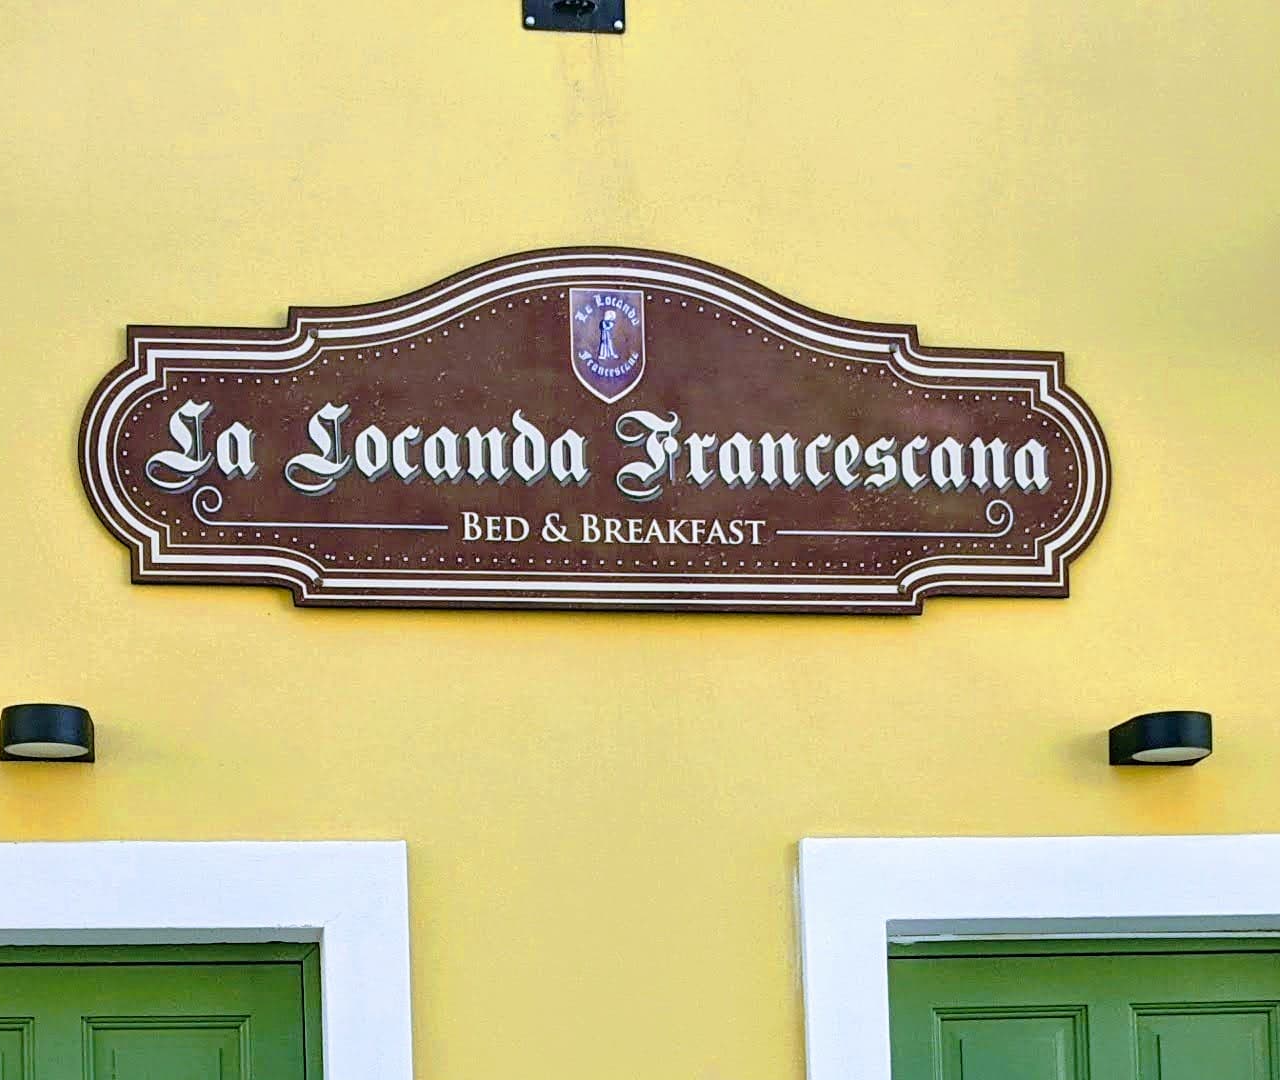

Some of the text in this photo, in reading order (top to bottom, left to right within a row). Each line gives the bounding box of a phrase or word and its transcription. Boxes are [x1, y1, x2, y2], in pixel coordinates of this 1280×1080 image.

[145, 399, 1051, 499] La Locanda Francescana
[541, 512, 572, 543] &
